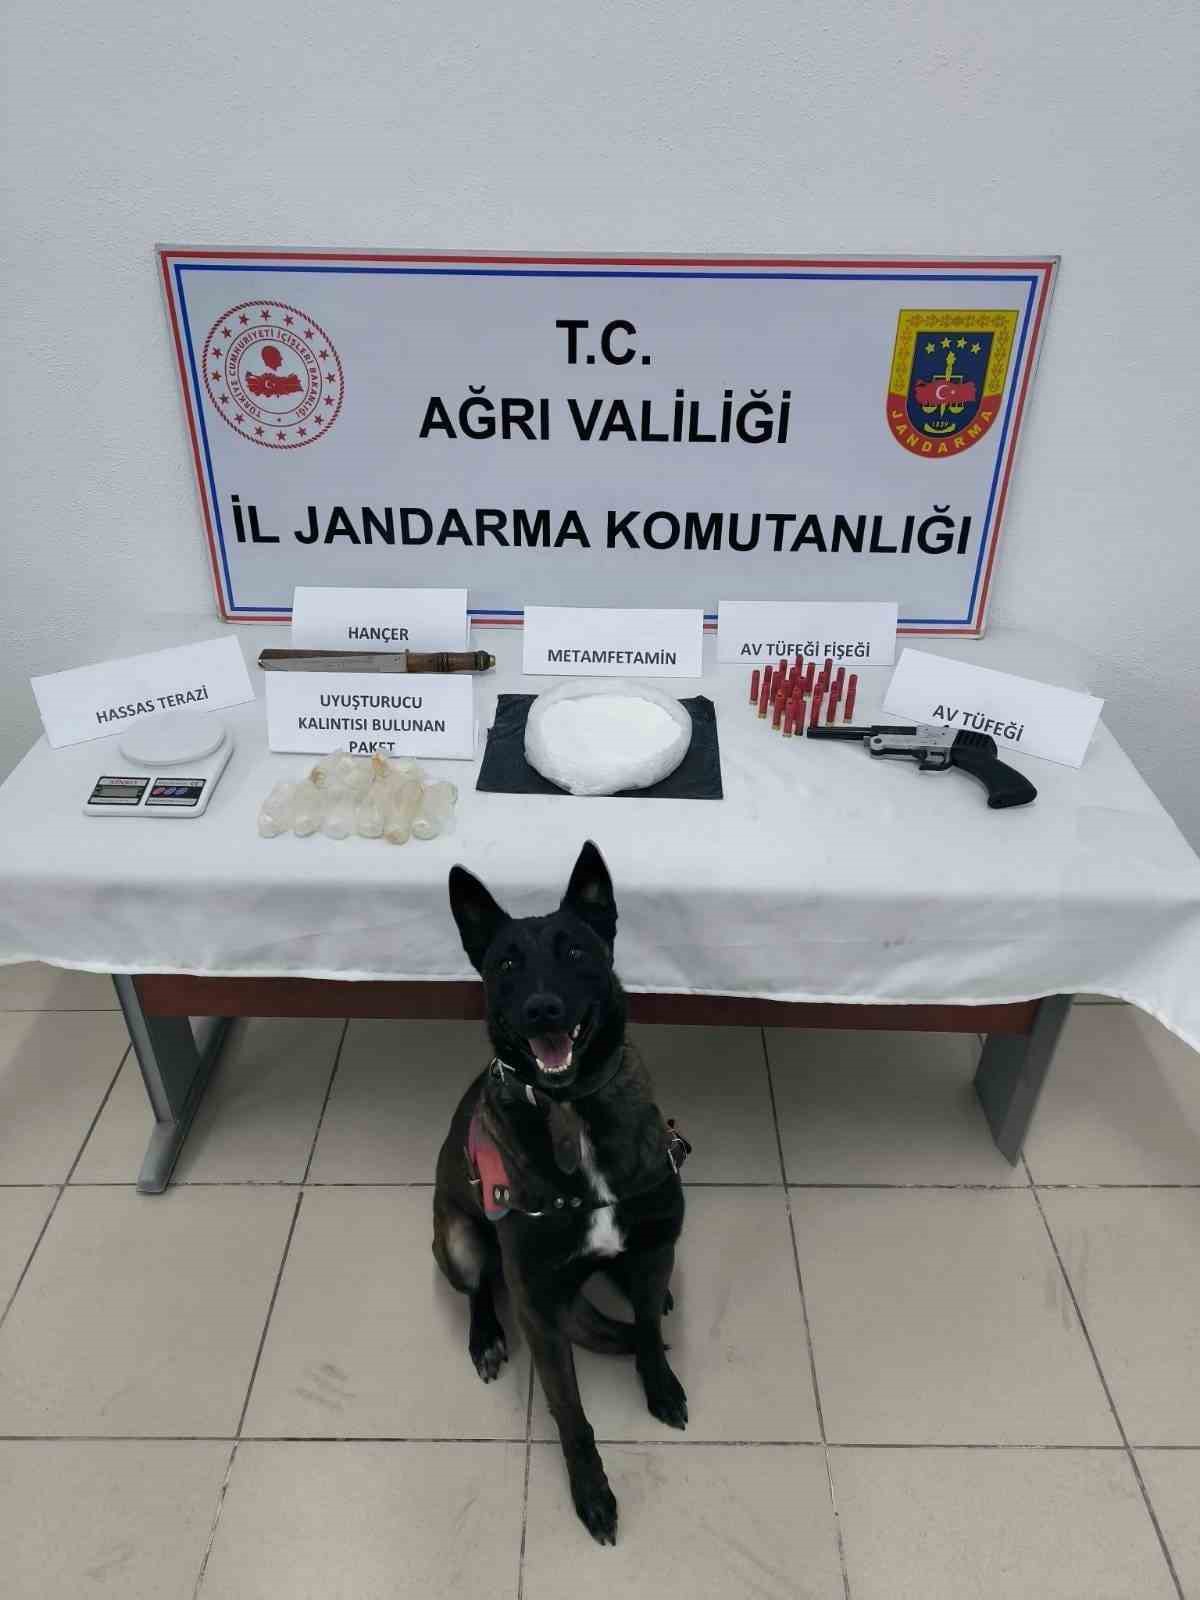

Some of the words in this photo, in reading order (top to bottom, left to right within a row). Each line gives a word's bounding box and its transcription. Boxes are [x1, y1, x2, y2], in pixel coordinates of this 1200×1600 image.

[556, 320, 650, 365] T.C.
[419, 385, 549, 440] AĞRI
[567, 389, 791, 444] VALİLİĞİ
[891, 409, 993, 453] JANDARMA
[231, 494, 281, 543] İL
[294, 506, 590, 548] JANDARMA
[607, 505, 971, 555] KOMUTANLIĞI
[348, 627, 409, 643] HANÇER
[740, 643, 762, 656] AV
[766, 641, 819, 657] TÜFEĞİ
[824, 641, 870, 660] FİŞEĞİ
[547, 647, 677, 665] METAMFETAMİN
[96, 700, 155, 724] HASSAS
[156, 684, 209, 709] TERAZİ
[320, 694, 422, 710] UYUŞTURUCU
[298, 717, 367, 730] KALINTISI
[372, 718, 446, 732] BULUNAN
[932, 704, 959, 721] AV
[962, 712, 1024, 742] TÜFEĞİ
